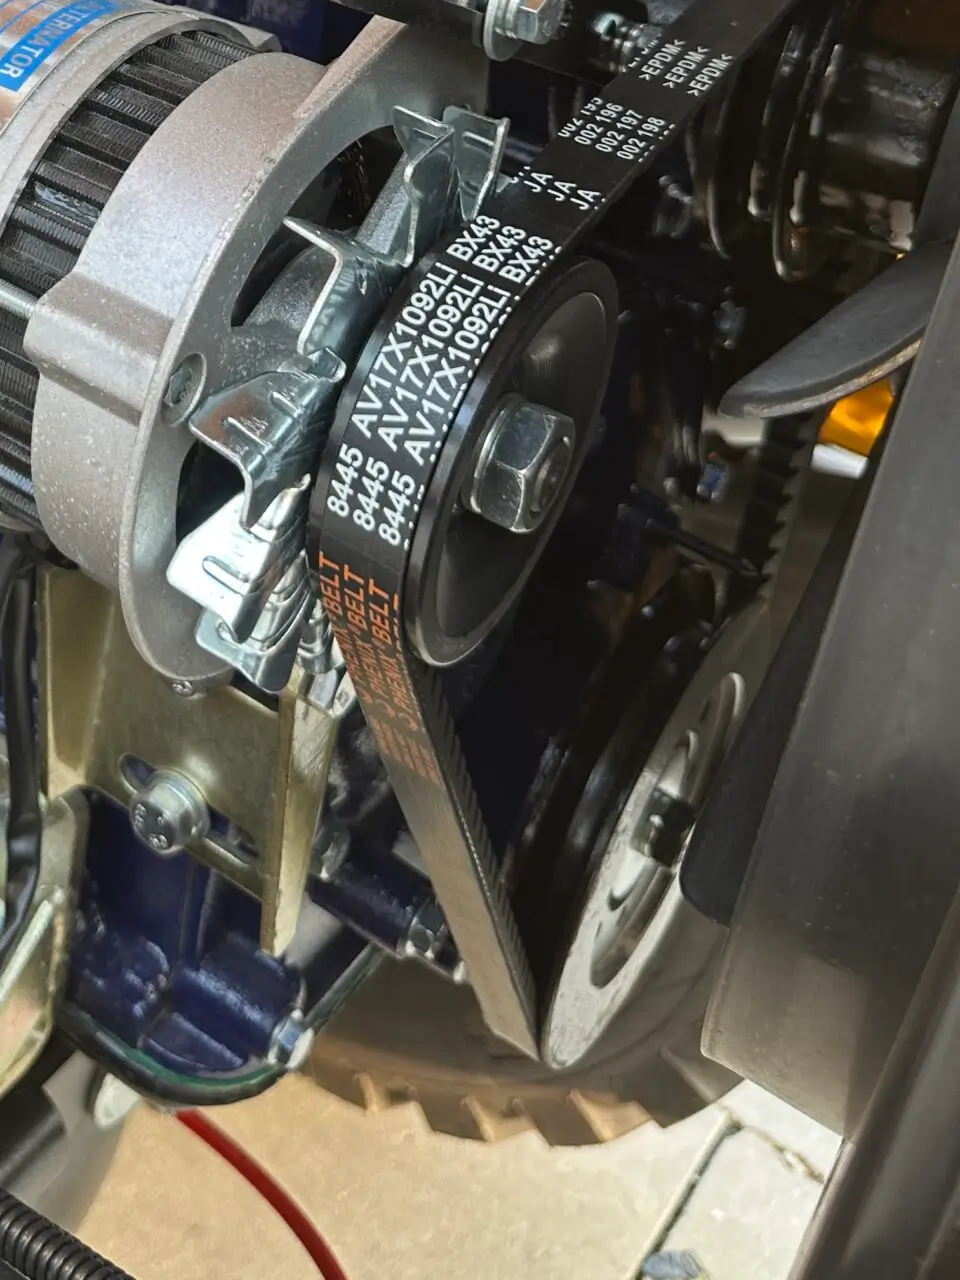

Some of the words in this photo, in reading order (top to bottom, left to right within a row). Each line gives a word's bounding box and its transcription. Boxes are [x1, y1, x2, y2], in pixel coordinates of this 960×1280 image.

[573, 122, 604, 146] 002
[594, 102, 624, 124] 196
[595, 130, 625, 153] 002
[616, 109, 643, 132] 197
[616, 137, 646, 161] 002
[637, 116, 666, 139] 198
[523, 171, 554, 193] JA
[547, 180, 577, 202] JA
[570, 188, 601, 211] JA
[326, 443, 364, 518] 8445
[350, 261, 458, 439] AV17X1092Li
[445, 215, 501, 262] BX43
[352, 456, 390, 532] 8445
[377, 273, 485, 452] AV17X1092Li
[471, 225, 527, 273] BX43
[378, 470, 416, 546] 8445
[403, 284, 512, 466] AV17X1092Li
[498, 235, 554, 284] BX43
[319, 550, 344, 617] BELT
[344, 563, 368, 631] BELT
[368, 577, 393, 646] BELT
